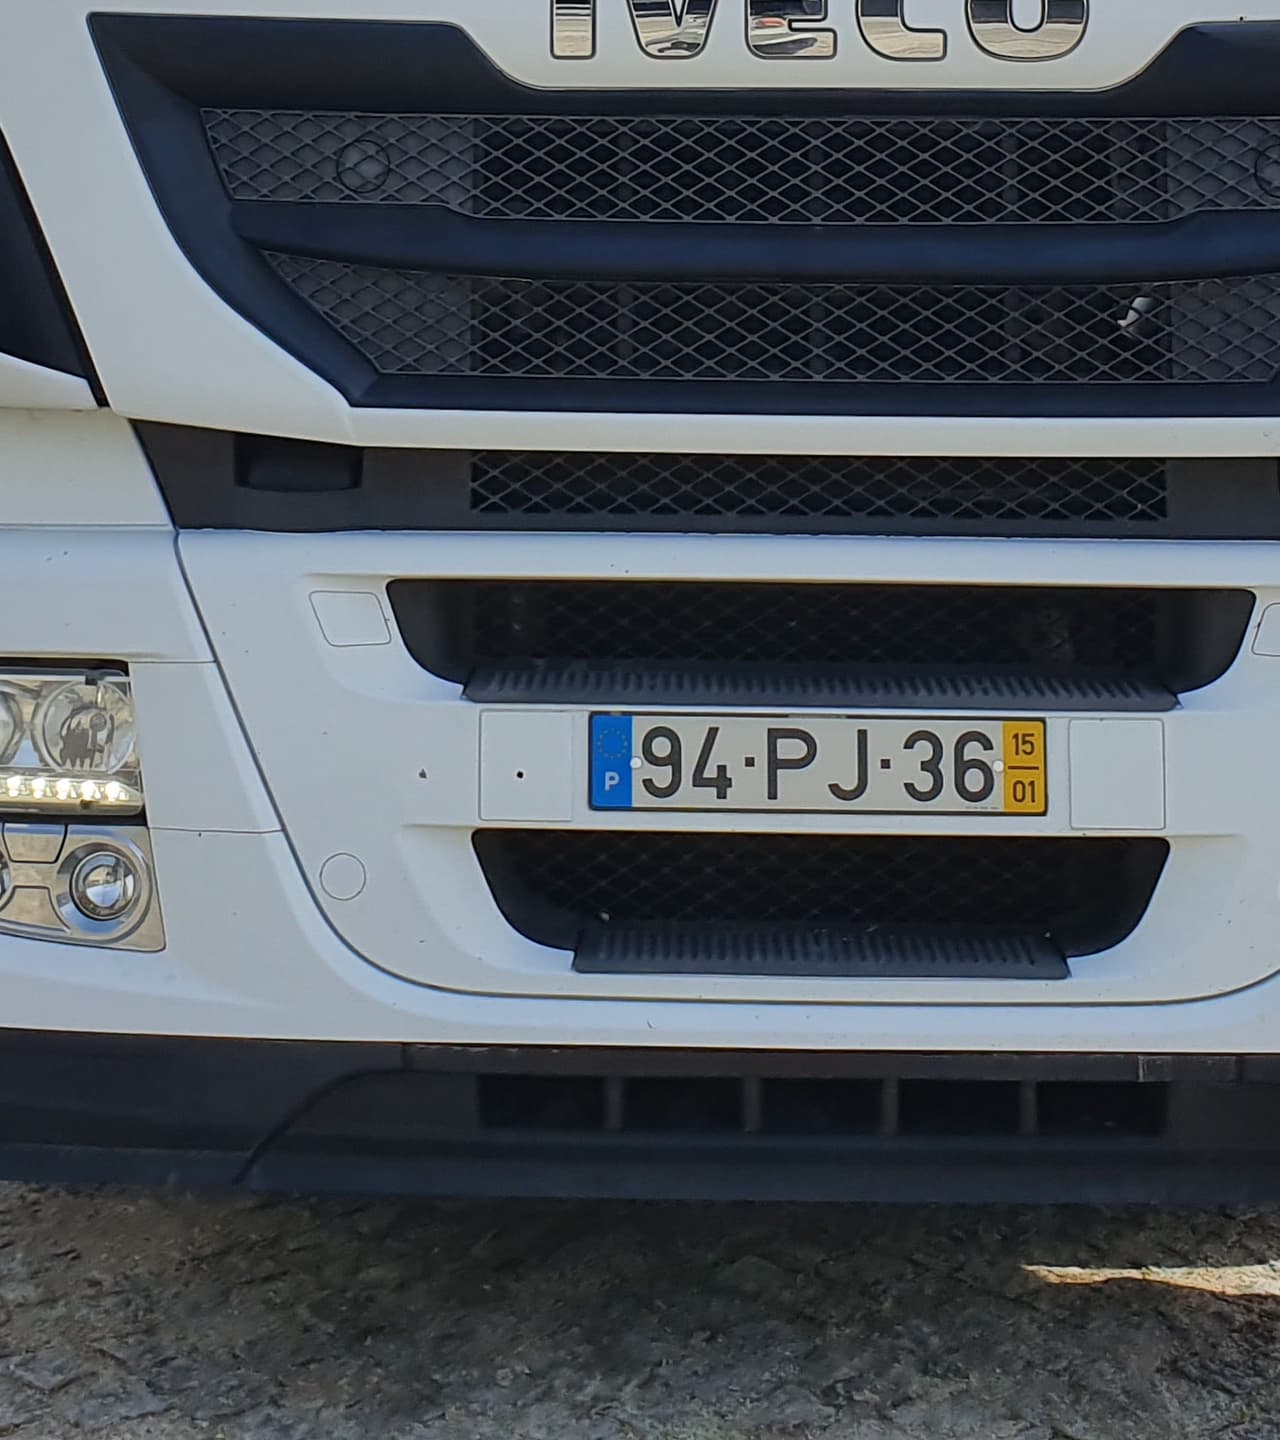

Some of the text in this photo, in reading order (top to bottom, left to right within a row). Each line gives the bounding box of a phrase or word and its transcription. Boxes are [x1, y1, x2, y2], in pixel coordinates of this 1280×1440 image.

[1010, 732, 1036, 757] 15
[603, 770, 620, 791] P
[1011, 778, 1037, 804] 01
